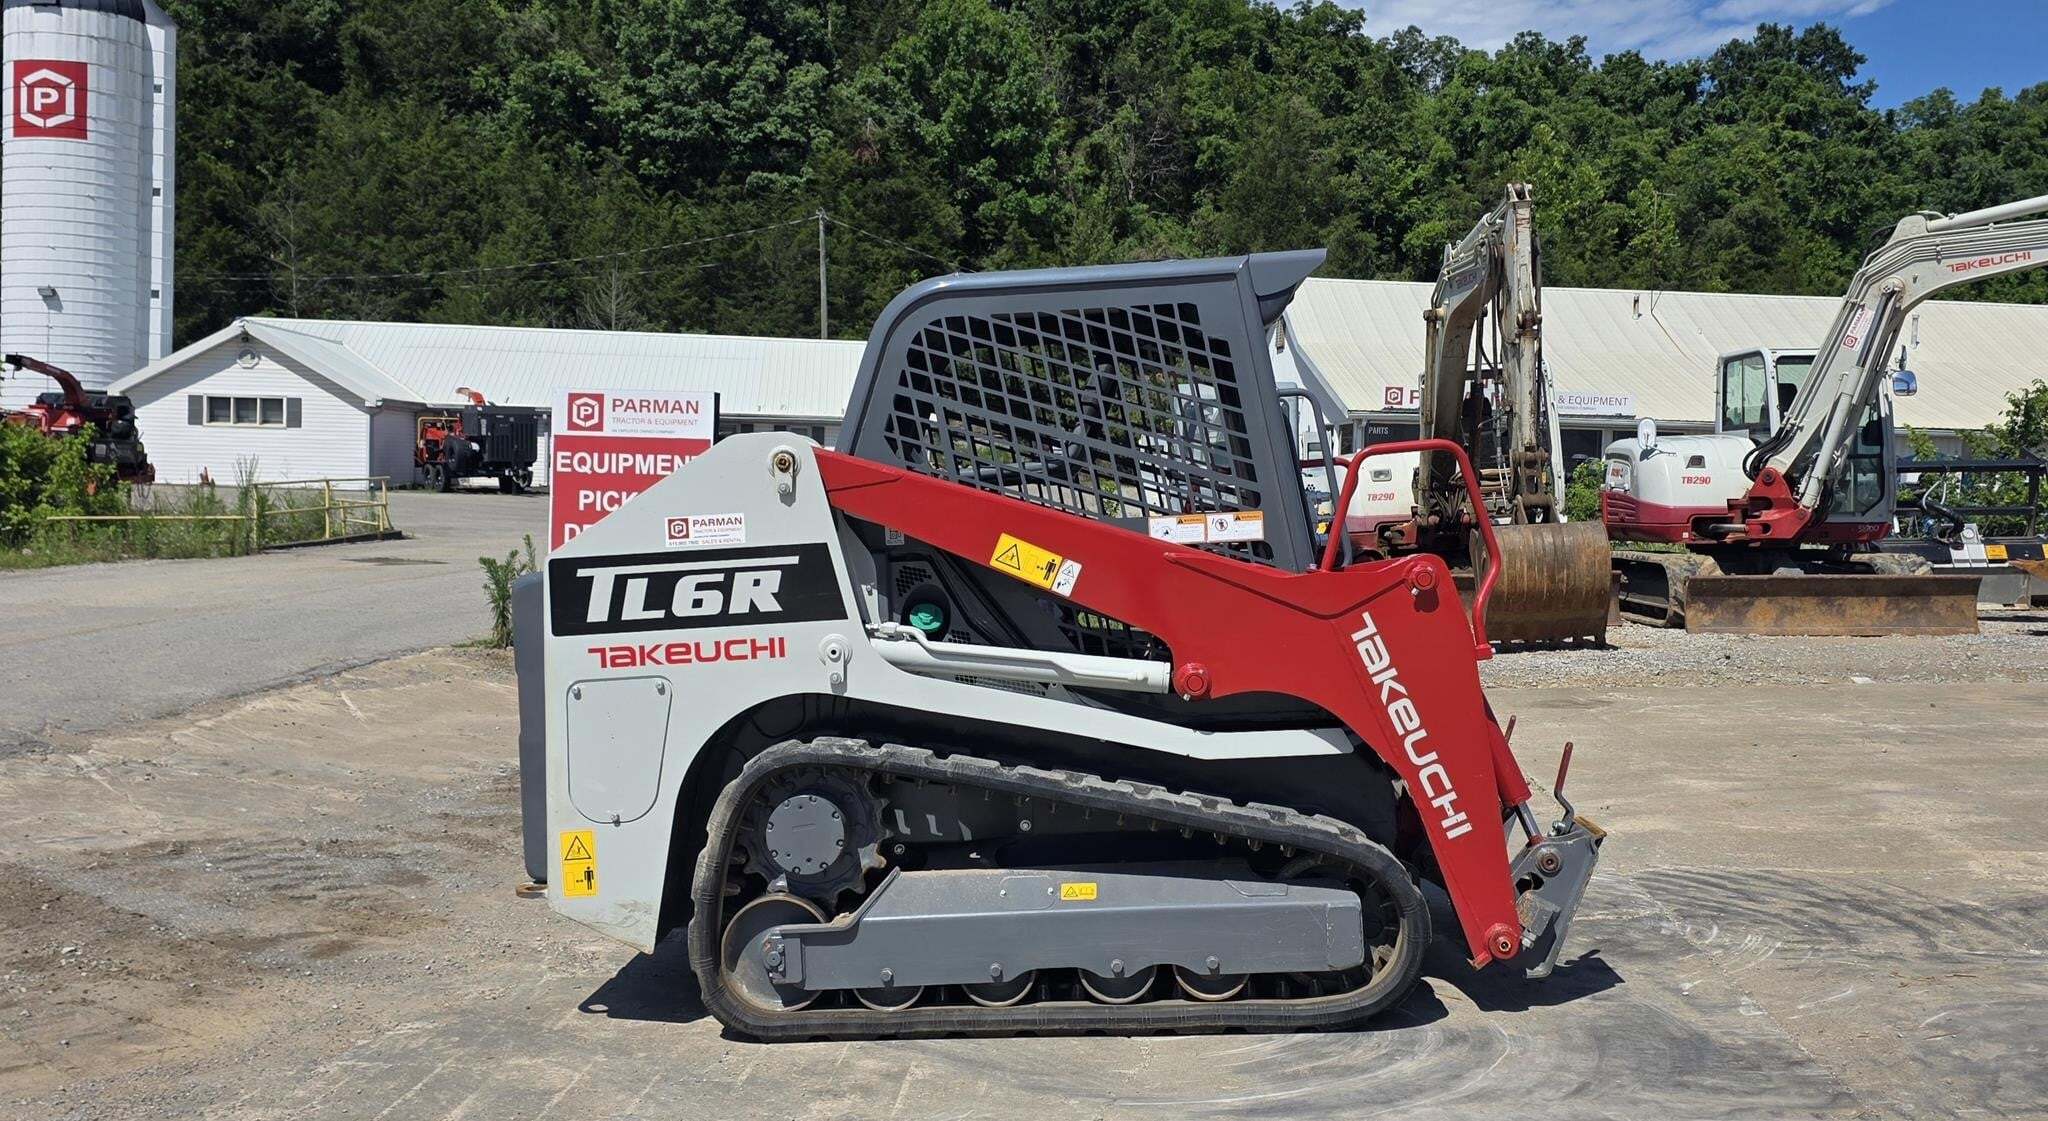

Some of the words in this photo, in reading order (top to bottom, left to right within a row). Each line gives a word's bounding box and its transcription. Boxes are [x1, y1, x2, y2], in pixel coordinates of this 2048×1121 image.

[1946, 251, 2032, 273] TAKEUCHI
[612, 398, 699, 415] PARMAN
[1568, 395, 1629, 406] EQUIPMENT
[612, 417, 647, 426] TRACTOR
[655, 418, 698, 427] EQUIPMENT
[1368, 427, 1389, 435] PARTS
[556, 451, 705, 475] EQUIPMEN
[1681, 476, 1711, 485] TB290
[1367, 492, 1395, 501] TB290
[692, 516, 742, 528] PARMAN
[576, 556, 799, 622] TL6R
[588, 637, 786, 669] TAKEUCHI
[1351, 611, 1473, 840] TAKEUCHI
